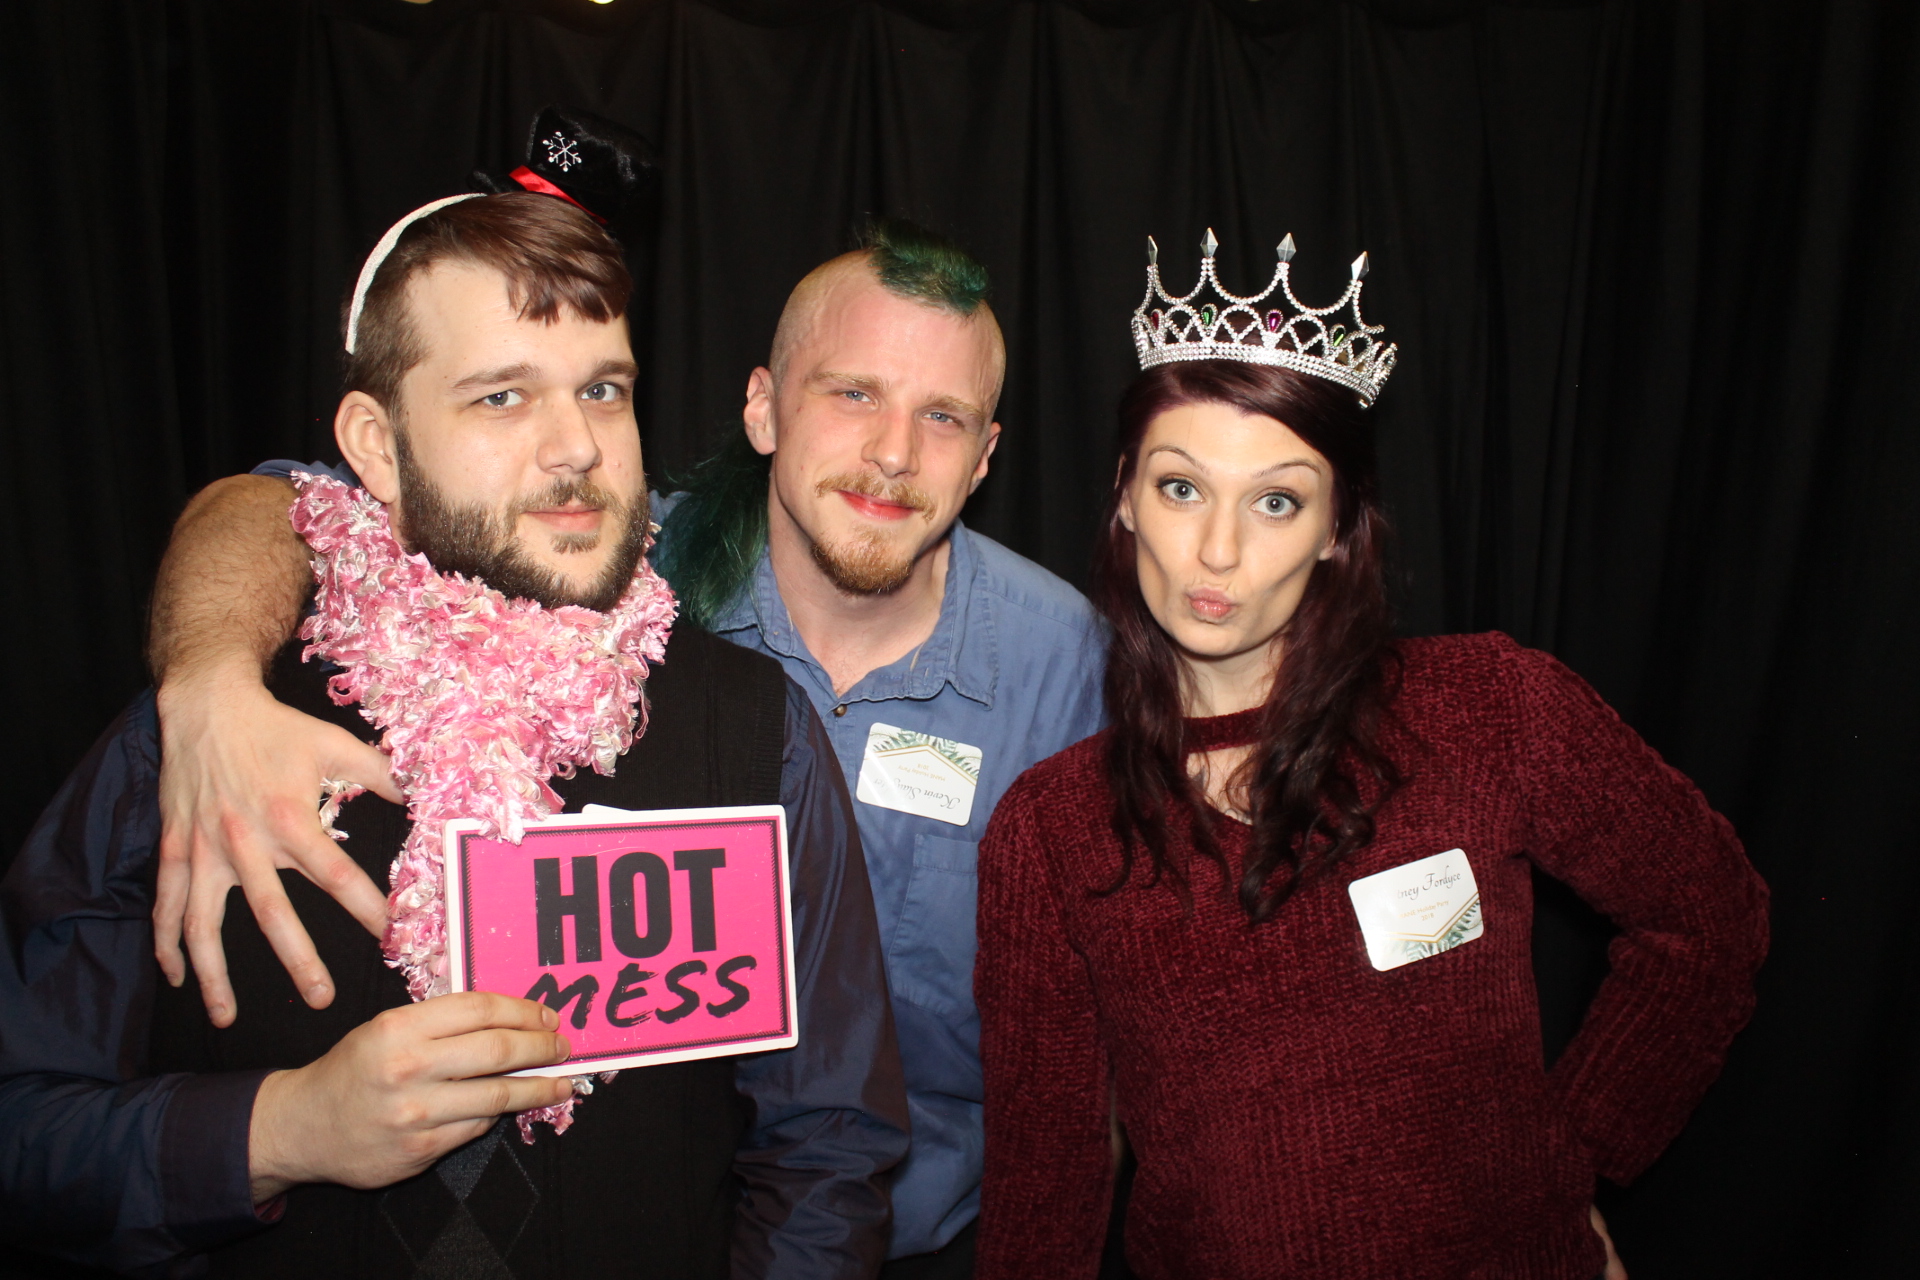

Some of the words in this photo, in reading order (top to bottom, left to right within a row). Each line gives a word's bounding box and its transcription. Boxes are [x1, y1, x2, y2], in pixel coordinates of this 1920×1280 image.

[924, 789, 961, 810] Kevin
[1422, 865, 1461, 890] Fordyce
[533, 847, 727, 967] HOT
[522, 955, 758, 1031] MESS
